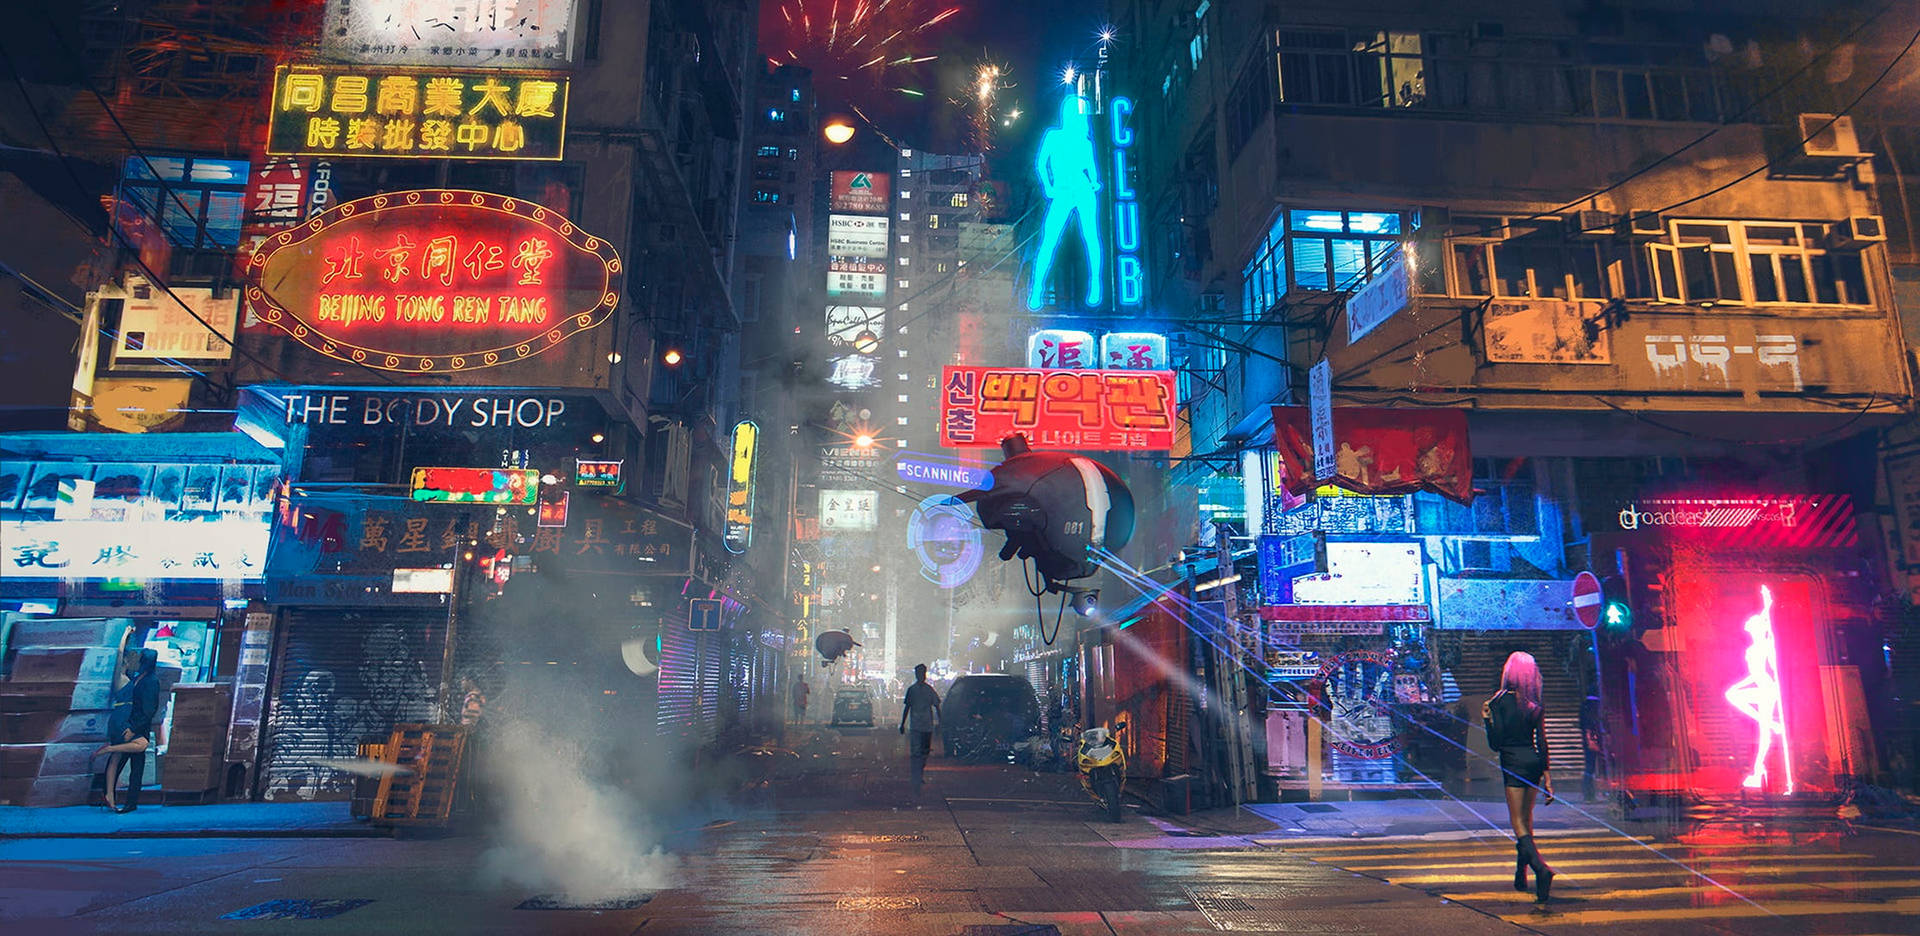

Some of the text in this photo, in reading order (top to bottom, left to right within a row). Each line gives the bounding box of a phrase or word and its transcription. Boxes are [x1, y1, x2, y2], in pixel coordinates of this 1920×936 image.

[282, 73, 557, 118] 同昌商業大廈
[307, 117, 524, 152] 時裝批發中心
[1110, 97, 1143, 306] CLUB
[831, 219, 853, 228] HSBC
[322, 234, 554, 286] 北京同仁堂
[319, 295, 547, 327] BEIJING TONG REN TANG
[282, 395, 350, 424] THE
[470, 399, 565, 428] SHOP
[946, 371, 975, 442] 신촌
[980, 372, 1171, 430] 백악관
[620, 519, 658, 536] 工程
[614, 544, 671, 557] 有限公司
